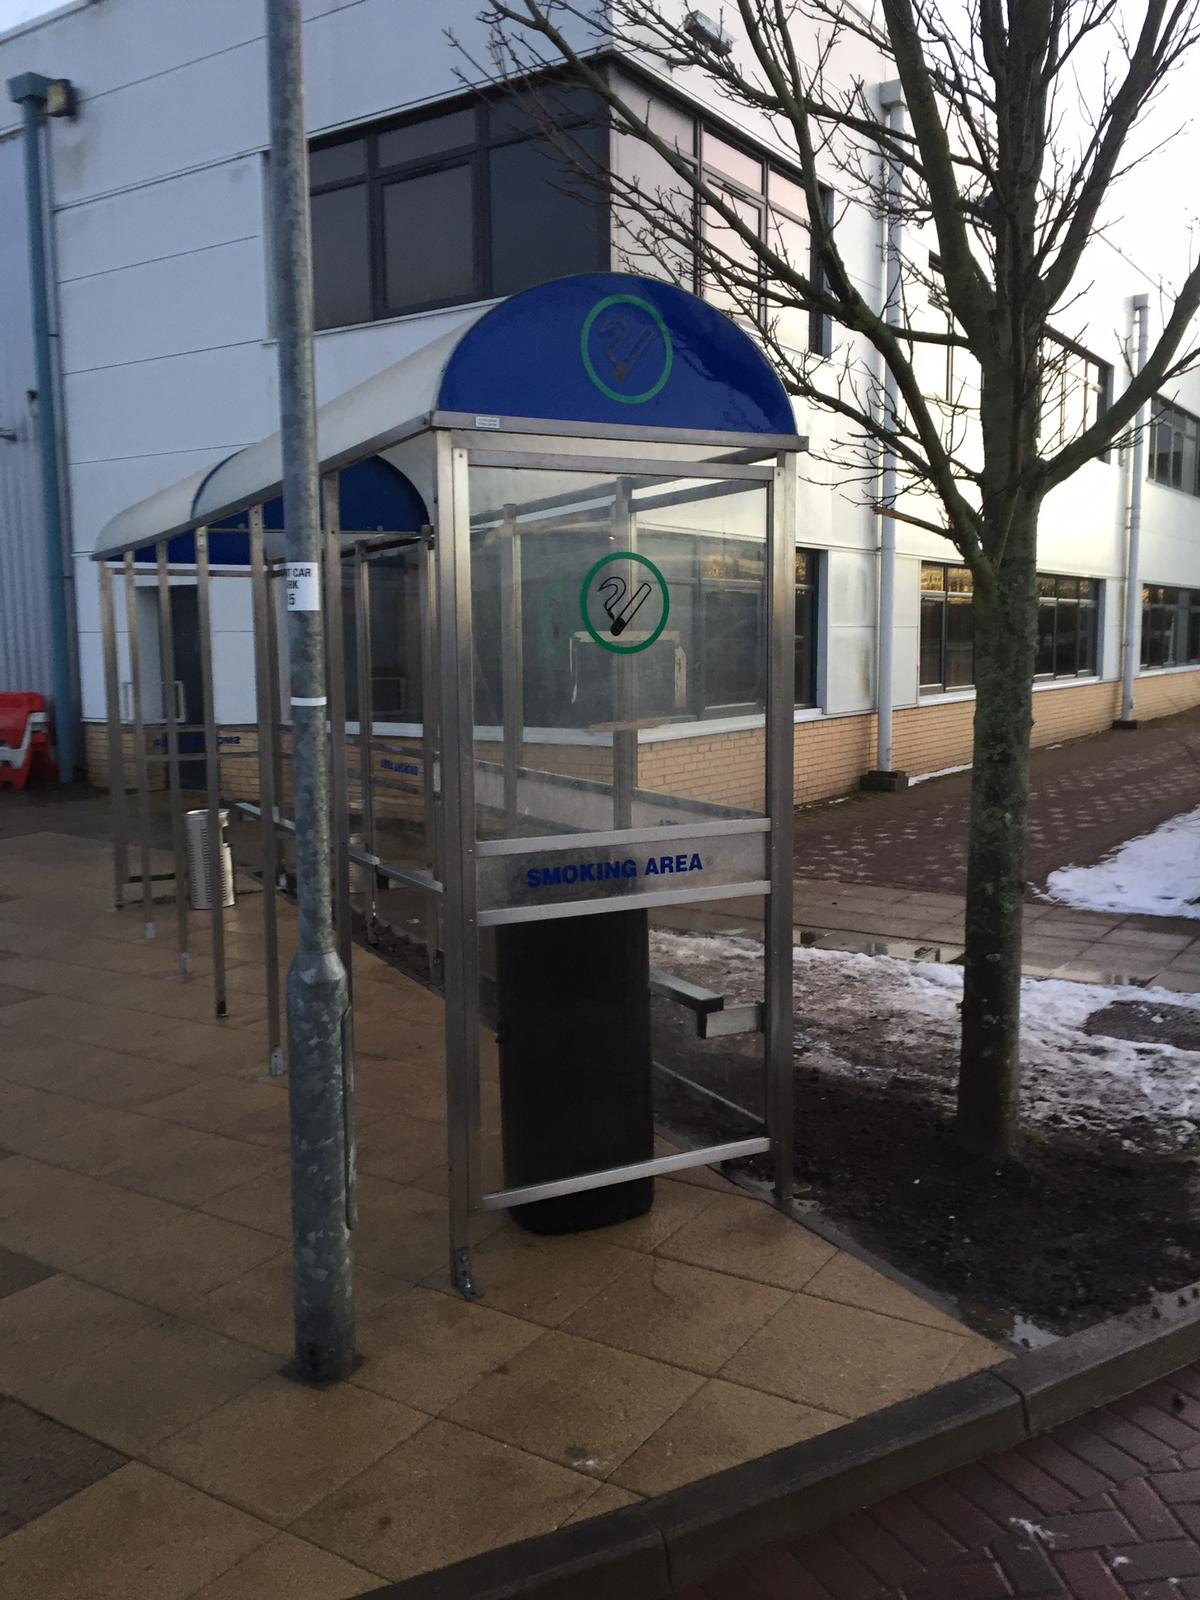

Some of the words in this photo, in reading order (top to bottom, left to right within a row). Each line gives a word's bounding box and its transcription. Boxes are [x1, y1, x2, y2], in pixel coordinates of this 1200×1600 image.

[293, 568, 311, 577] CAR
[527, 859, 638, 888] SMOKING
[644, 853, 703, 875] AREA
